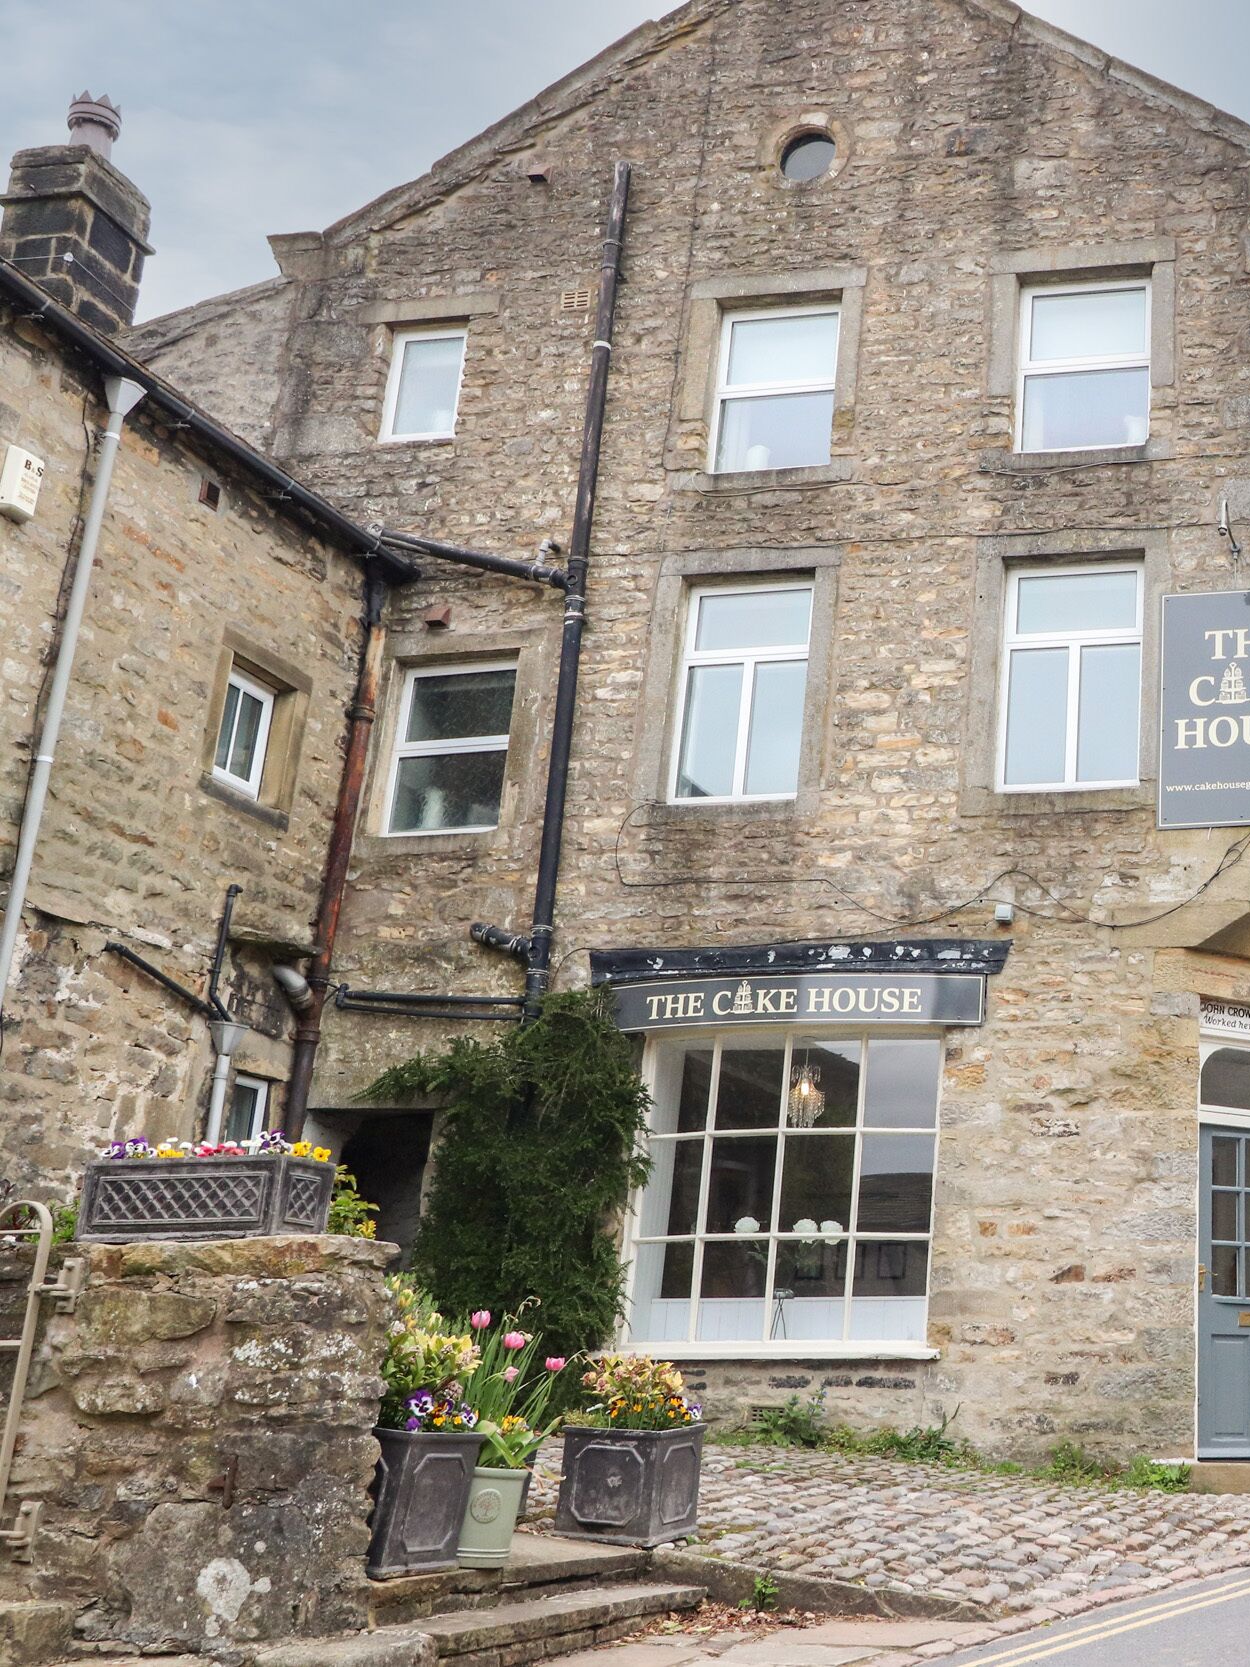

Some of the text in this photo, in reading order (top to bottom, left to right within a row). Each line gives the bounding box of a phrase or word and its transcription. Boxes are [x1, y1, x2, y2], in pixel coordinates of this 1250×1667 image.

[646, 991, 705, 1020] THE
[806, 988, 922, 1014] HOUSE
[1200, 1003, 1225, 1015] JOHN
[1203, 1014, 1237, 1028] Worked
